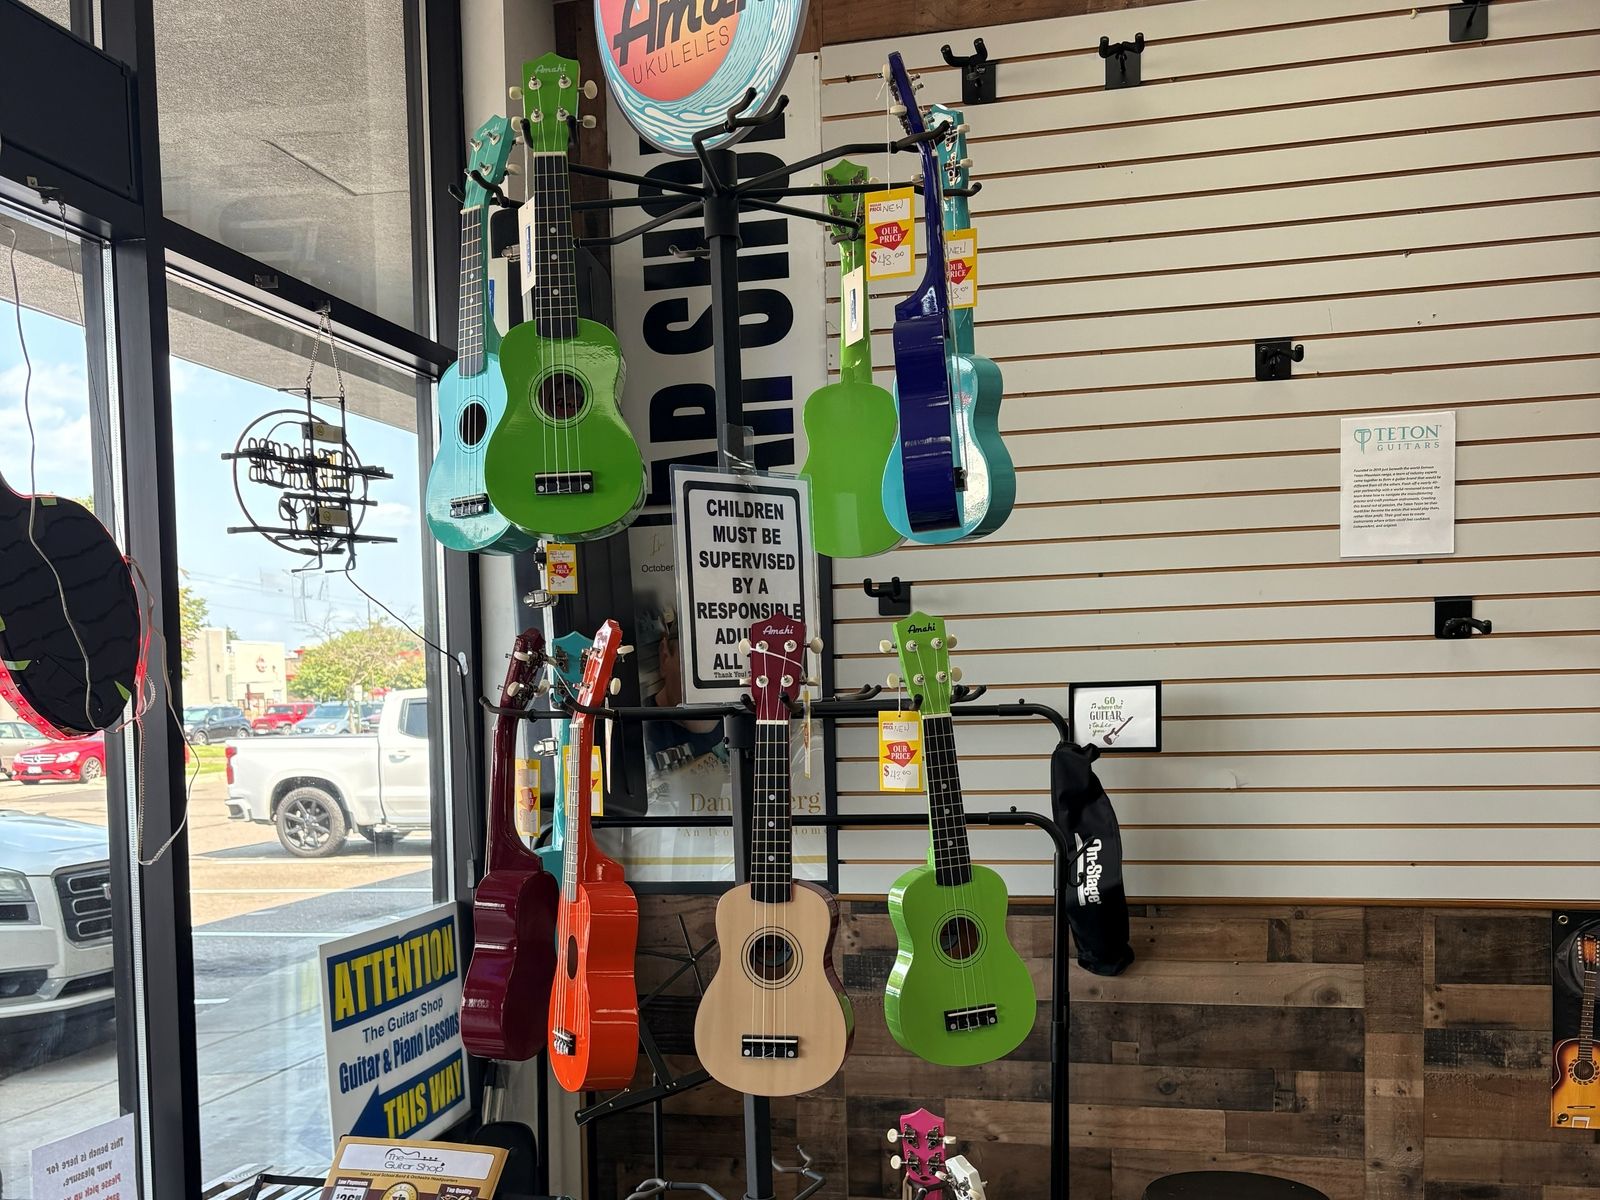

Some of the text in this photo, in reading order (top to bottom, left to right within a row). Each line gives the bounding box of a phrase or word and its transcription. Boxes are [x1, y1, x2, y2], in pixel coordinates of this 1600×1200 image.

[613, 0, 747, 67] Ama
[632, 25, 730, 84] UKULELES
[535, 63, 567, 74] Amahi
[880, 234, 902, 243] PRICE
[881, 226, 898, 235] OUR
[950, 269, 967, 278] RICE
[1374, 425, 1440, 441] TETON
[1377, 442, 1440, 451] GUITARS
[707, 499, 784, 520] CHILDREN
[713, 526, 781, 545] MUST BE
[642, 564, 674, 572] October
[700, 551, 795, 570] SUPERVISED
[733, 578, 769, 594] BY A
[763, 625, 794, 635] Amahi
[907, 622, 936, 634] Amahi
[715, 628, 751, 645] ADU
[713, 653, 743, 670] ALL
[1104, 697, 1115, 705] GO
[1090, 711, 1122, 721] GUITAR
[334, 924, 455, 1021] ATTENTION
[362, 997, 443, 1043] The Guitar Shop
[339, 1011, 460, 1094] Guitar & Piano Lessons
[384, 1058, 462, 1139] THIS WAY
[388, 1153, 404, 1161] The
[385, 1161, 444, 1173] Guitar Shop
